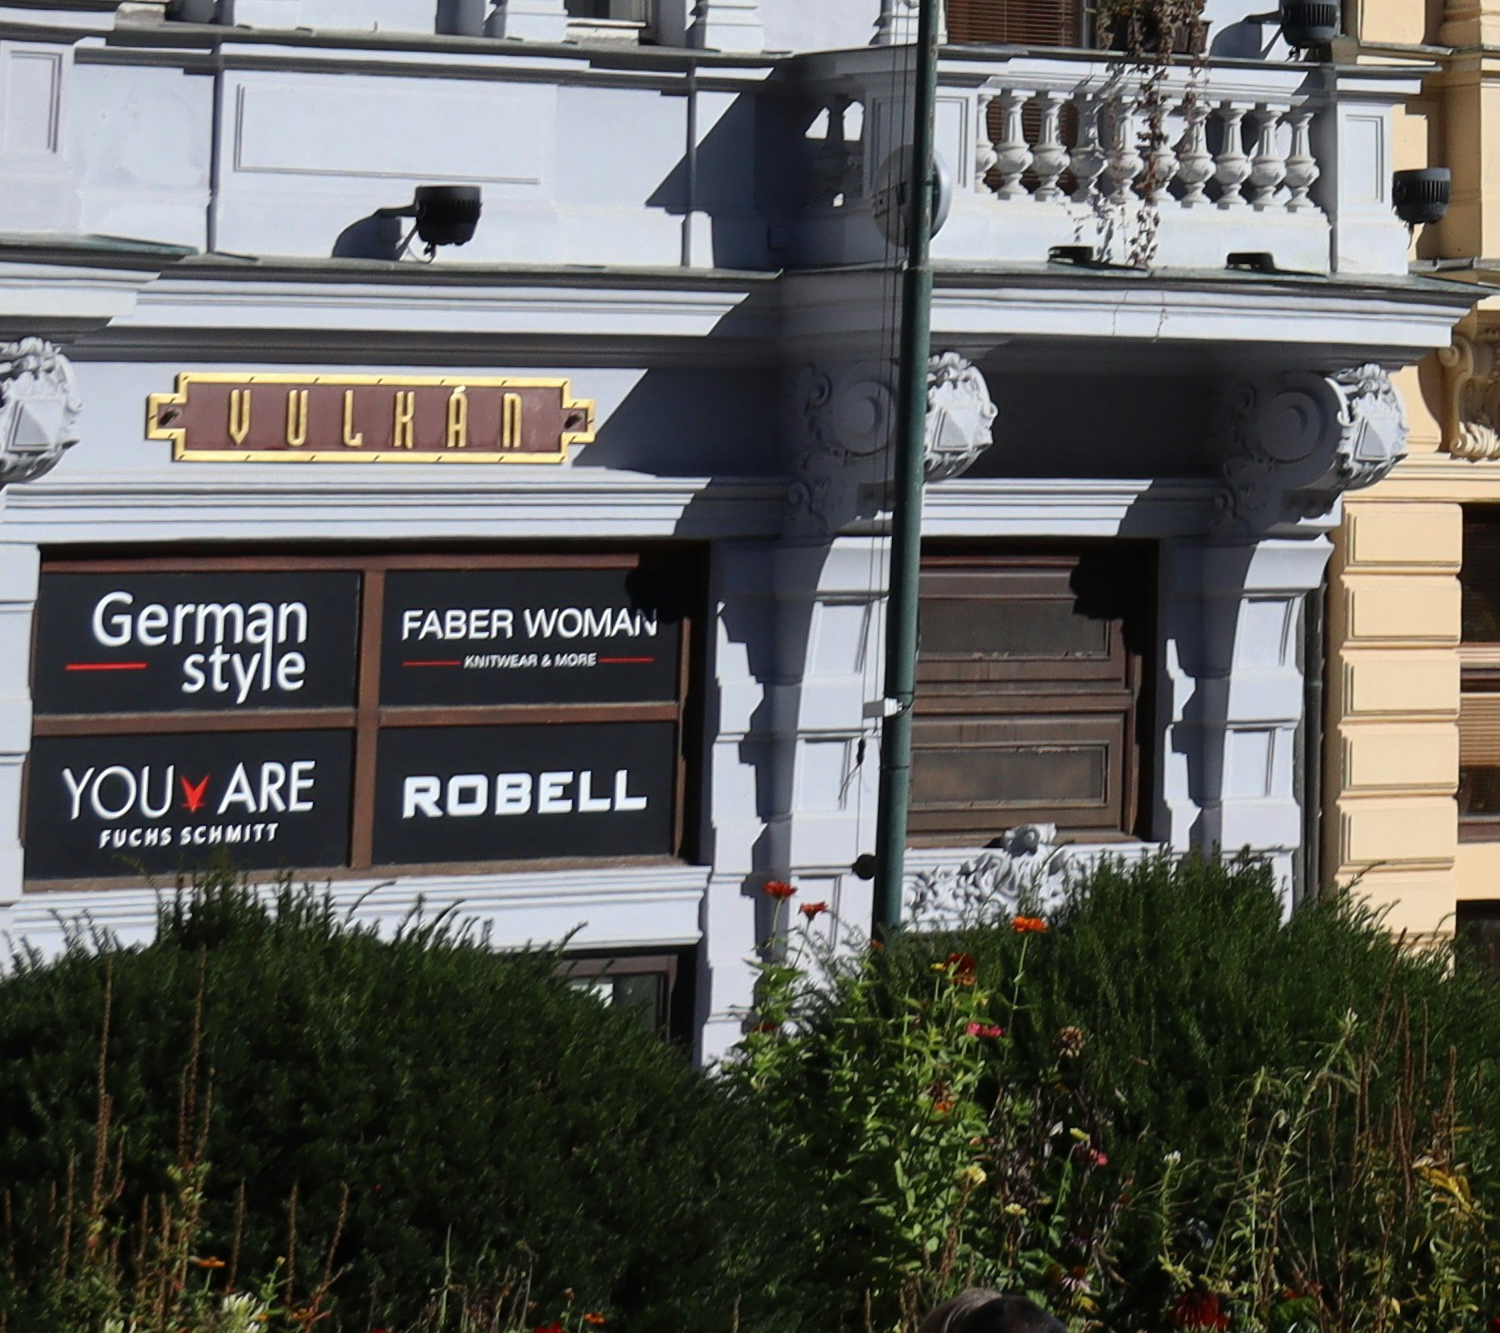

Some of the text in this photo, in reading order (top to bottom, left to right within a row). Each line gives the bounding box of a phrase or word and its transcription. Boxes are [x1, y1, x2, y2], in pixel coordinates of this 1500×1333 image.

[228, 385, 523, 449] VULKÁN
[92, 590, 308, 648] German
[401, 607, 658, 641] FABER WOMAN
[181, 641, 306, 704] style
[464, 652, 598, 669] KNITWEAR & MORE
[62, 760, 316, 820] YOU ARE
[402, 769, 648, 819] ROBELL
[98, 823, 279, 850] FUCHS SCHMITT
